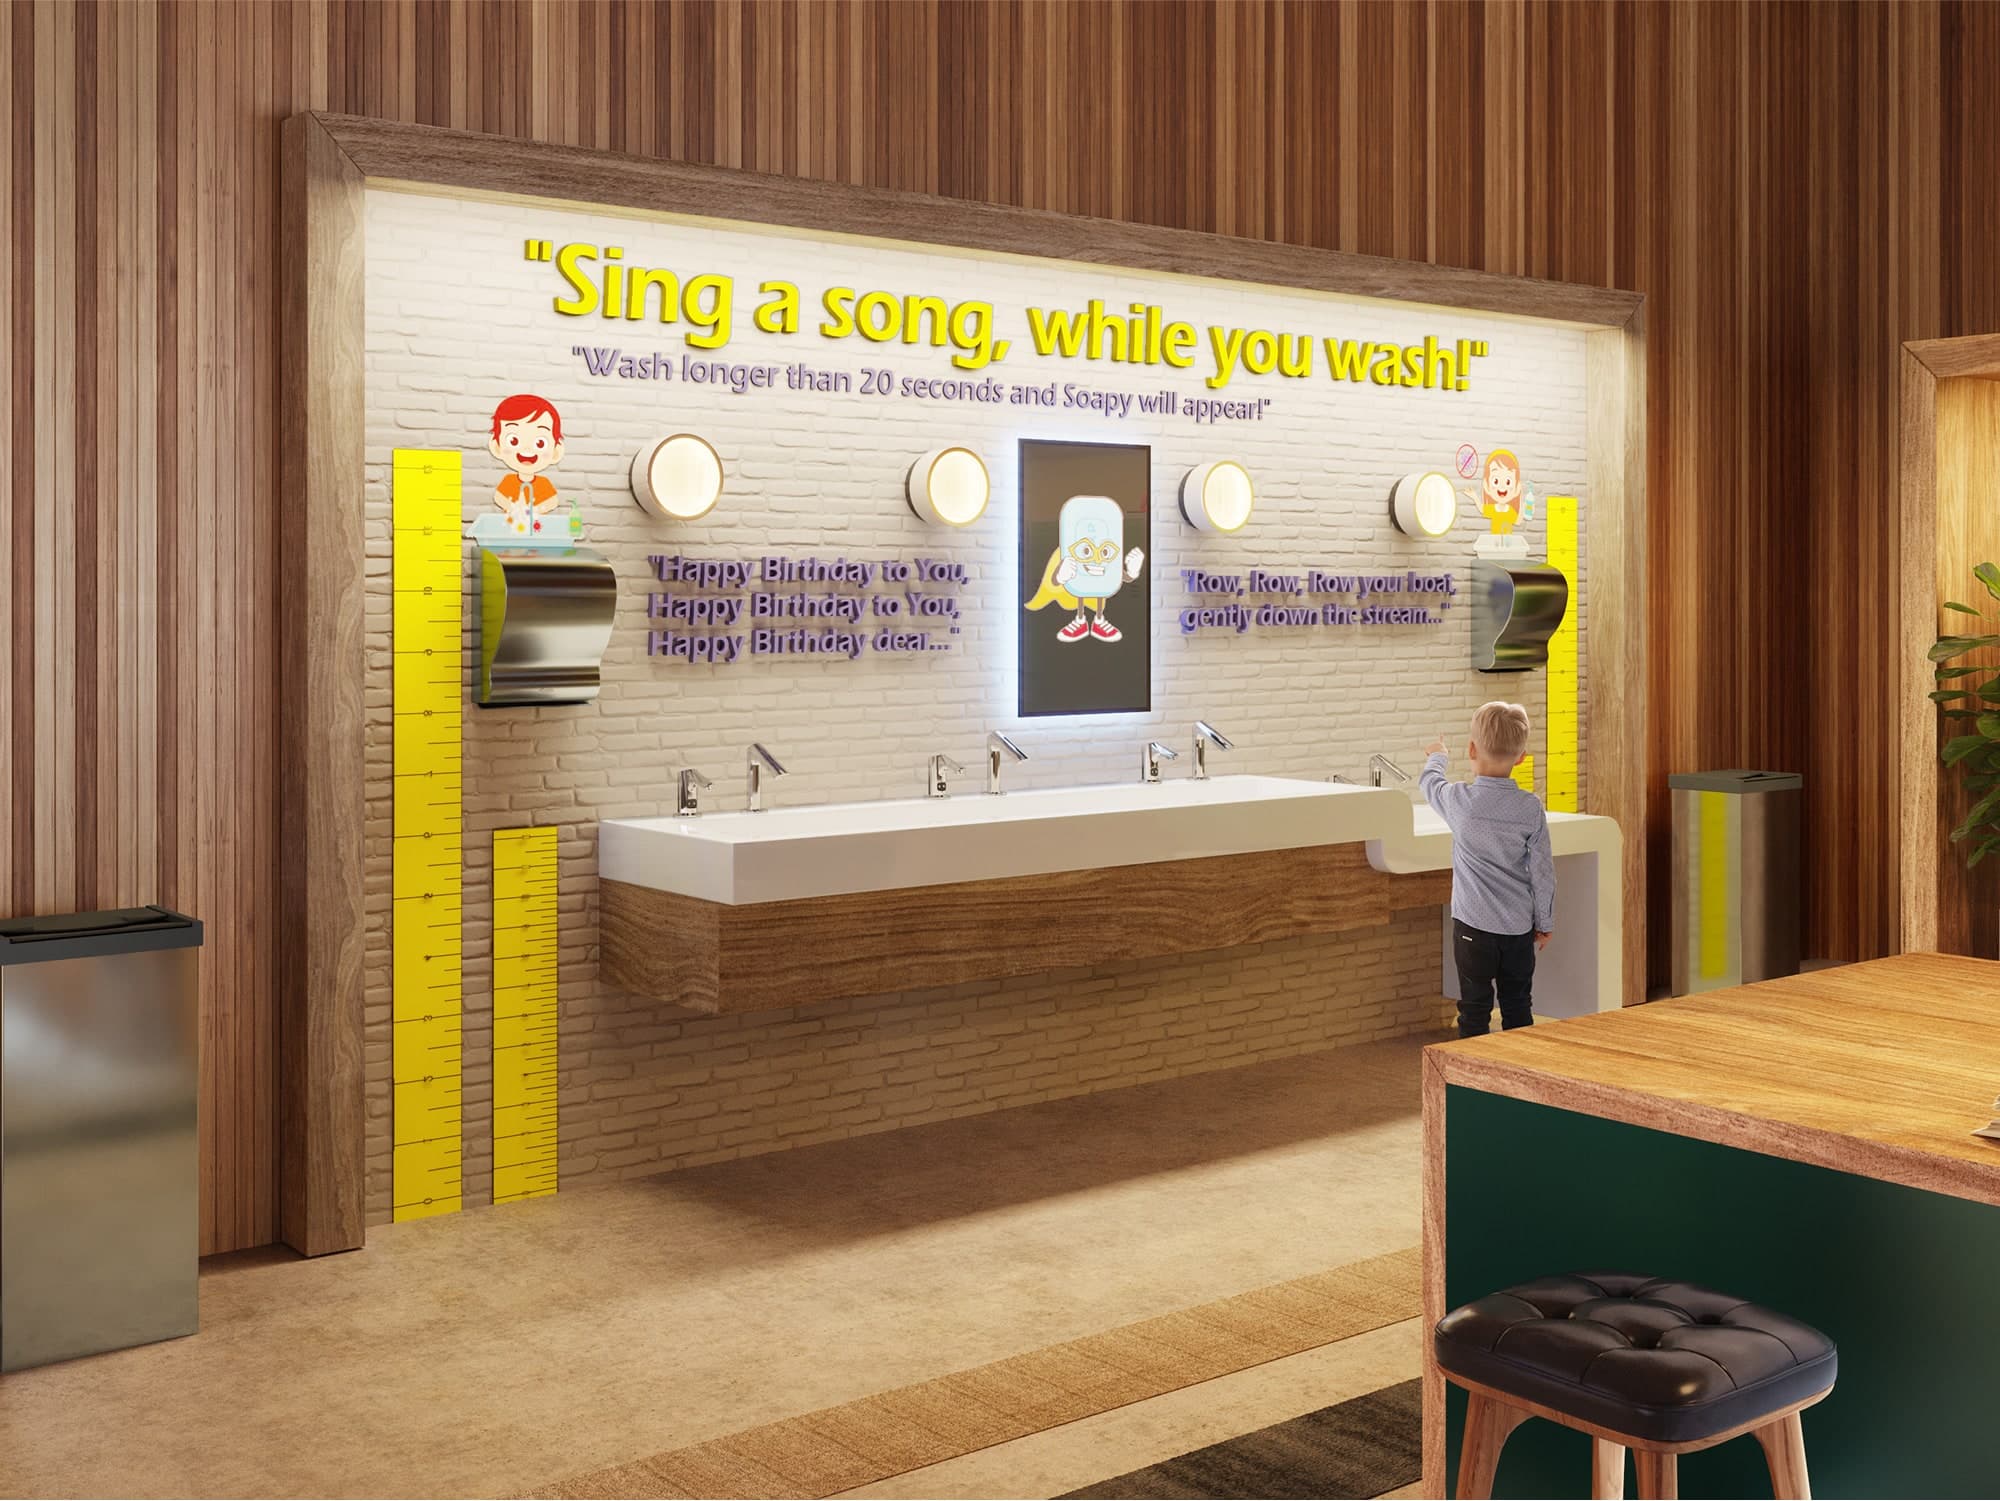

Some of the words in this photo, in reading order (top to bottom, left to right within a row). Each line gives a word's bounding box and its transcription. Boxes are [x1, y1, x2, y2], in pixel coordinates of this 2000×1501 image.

[524, 239, 734, 349] "Sing
[754, 279, 800, 335] a
[819, 285, 1010, 370] song,
[1026, 299, 1197, 368] while
[1205, 324, 1313, 389] you
[1324, 335, 1488, 391] wash!"
[571, 346, 671, 381] "Wash
[681, 354, 779, 394] longer
[786, 363, 851, 394] than
[860, 368, 894, 396] 20
[900, 375, 1002, 404] seconds
[1009, 382, 1056, 407] and
[1063, 383, 1133, 418] Soapy
[1138, 390, 1177, 415] will
[1182, 396, 1271, 423] appear!"
[648, 555, 753, 588] "Happy
[761, 556, 878, 588] Birthday
[882, 560, 911, 581] to
[914, 557, 971, 585] You,
[1180, 569, 1244, 596] "Row,
[1250, 570, 1303, 596] Row,
[1308, 570, 1354, 593] Row
[1355, 575, 1406, 599] your
[1407, 571, 1456, 596] boat,
[647, 592, 744, 625] Happy
[751, 591, 868, 625] Birthday
[872, 594, 898, 617] to
[904, 591, 961, 619] You,
[1179, 603, 1253, 634] gently
[1256, 603, 1319, 626] down
[1322, 603, 1359, 625] the
[647, 630, 744, 663] Happy
[751, 628, 867, 660] Birthday
